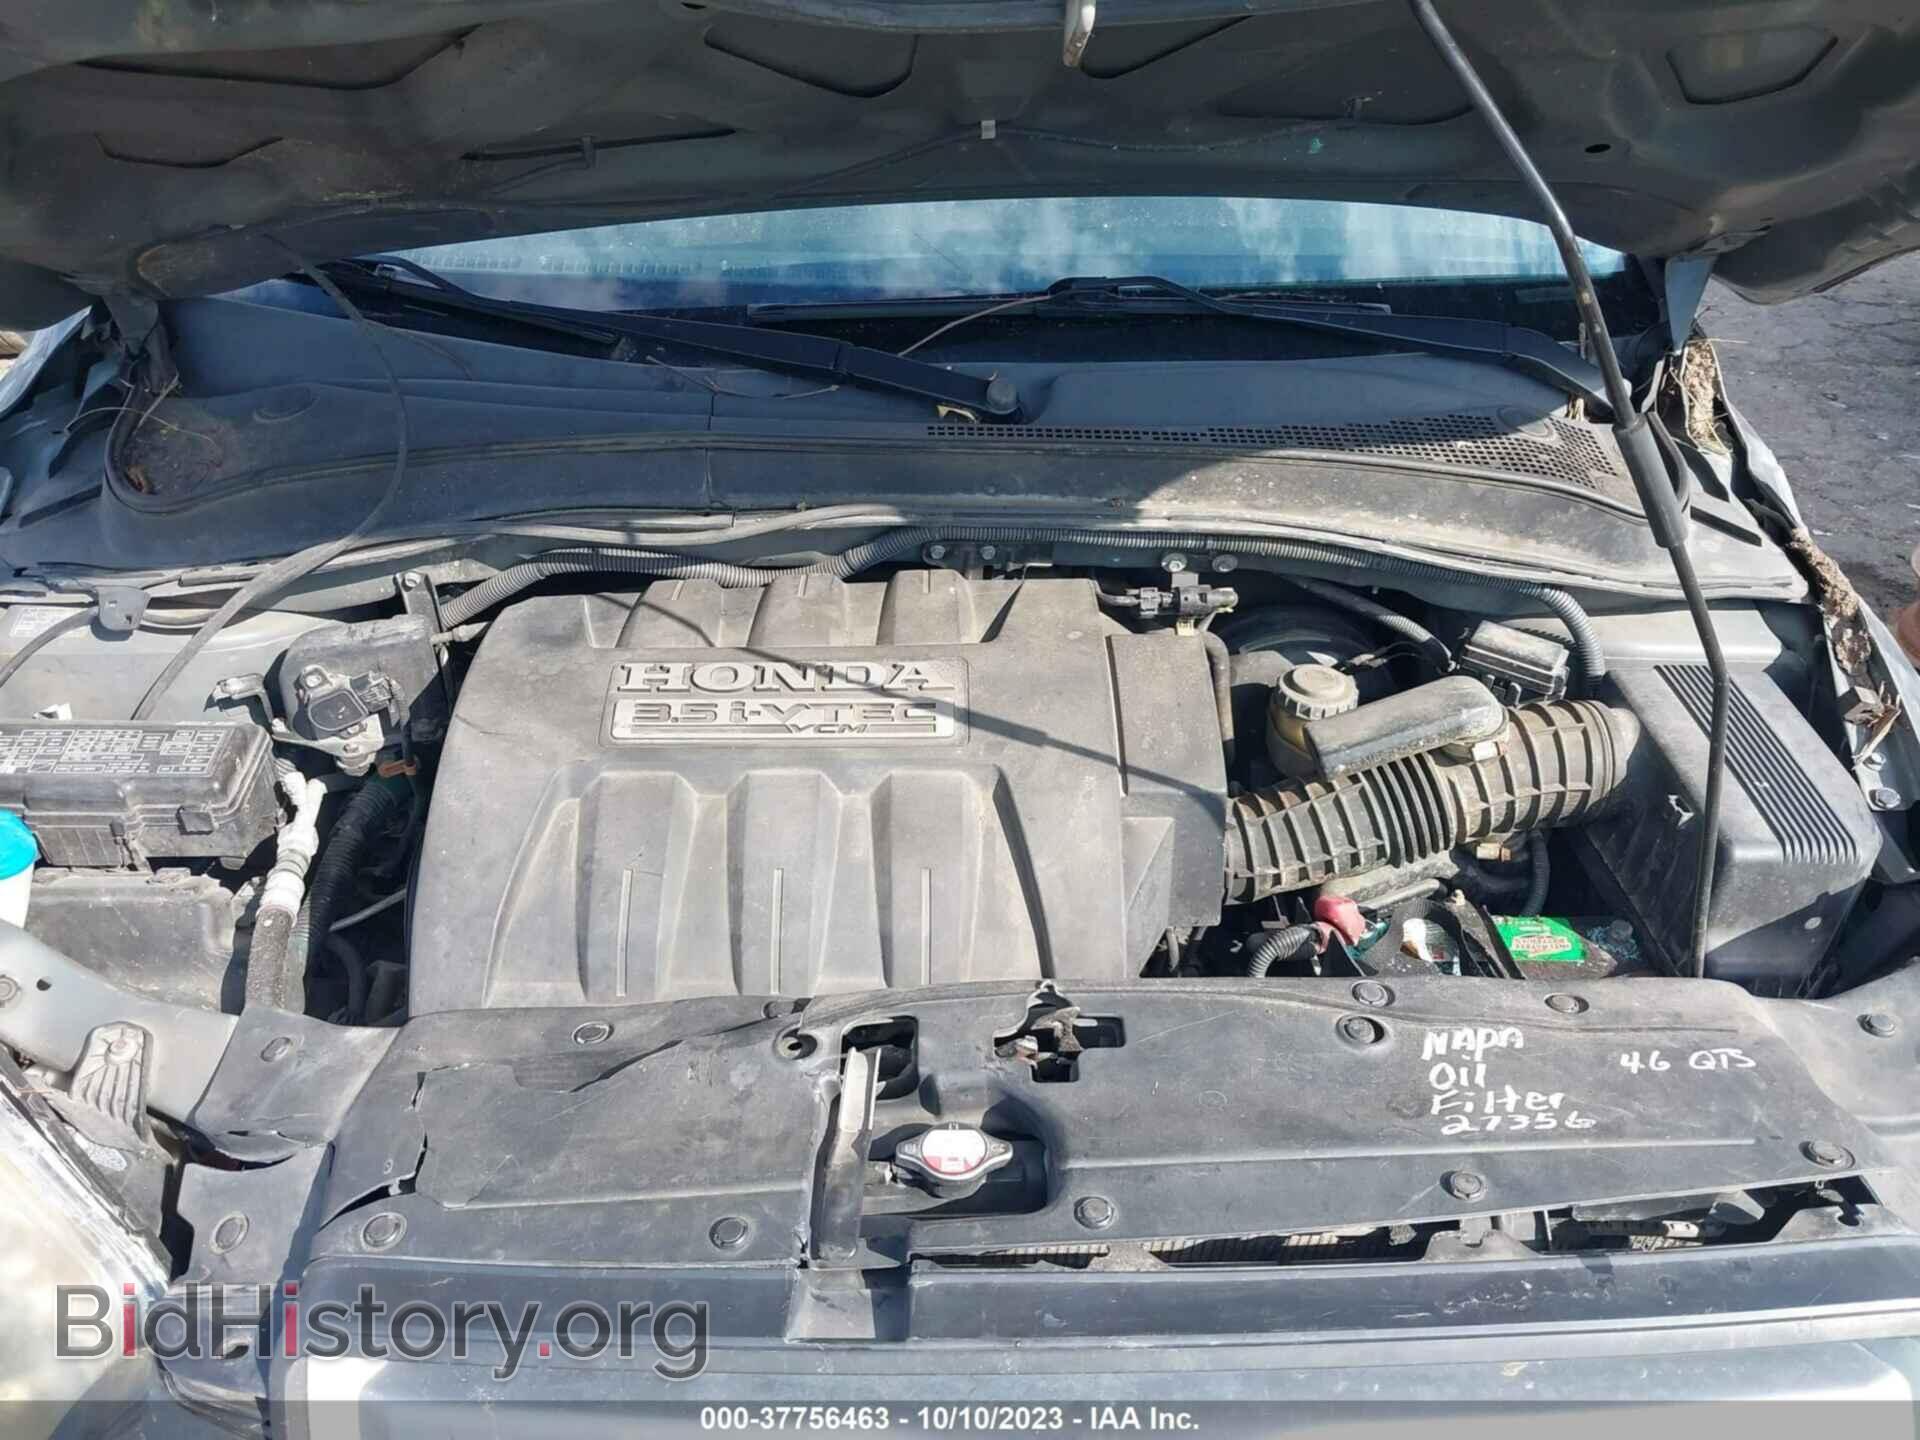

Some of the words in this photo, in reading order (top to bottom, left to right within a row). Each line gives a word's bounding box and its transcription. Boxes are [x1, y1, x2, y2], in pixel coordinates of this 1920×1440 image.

[617, 662, 954, 693] HONDA
[1429, 1054, 1487, 1090] Oil
[1688, 1048, 1757, 1070] QTS
[1430, 1084, 1565, 1115] Filter
[1440, 1110, 1596, 1136] 27356
